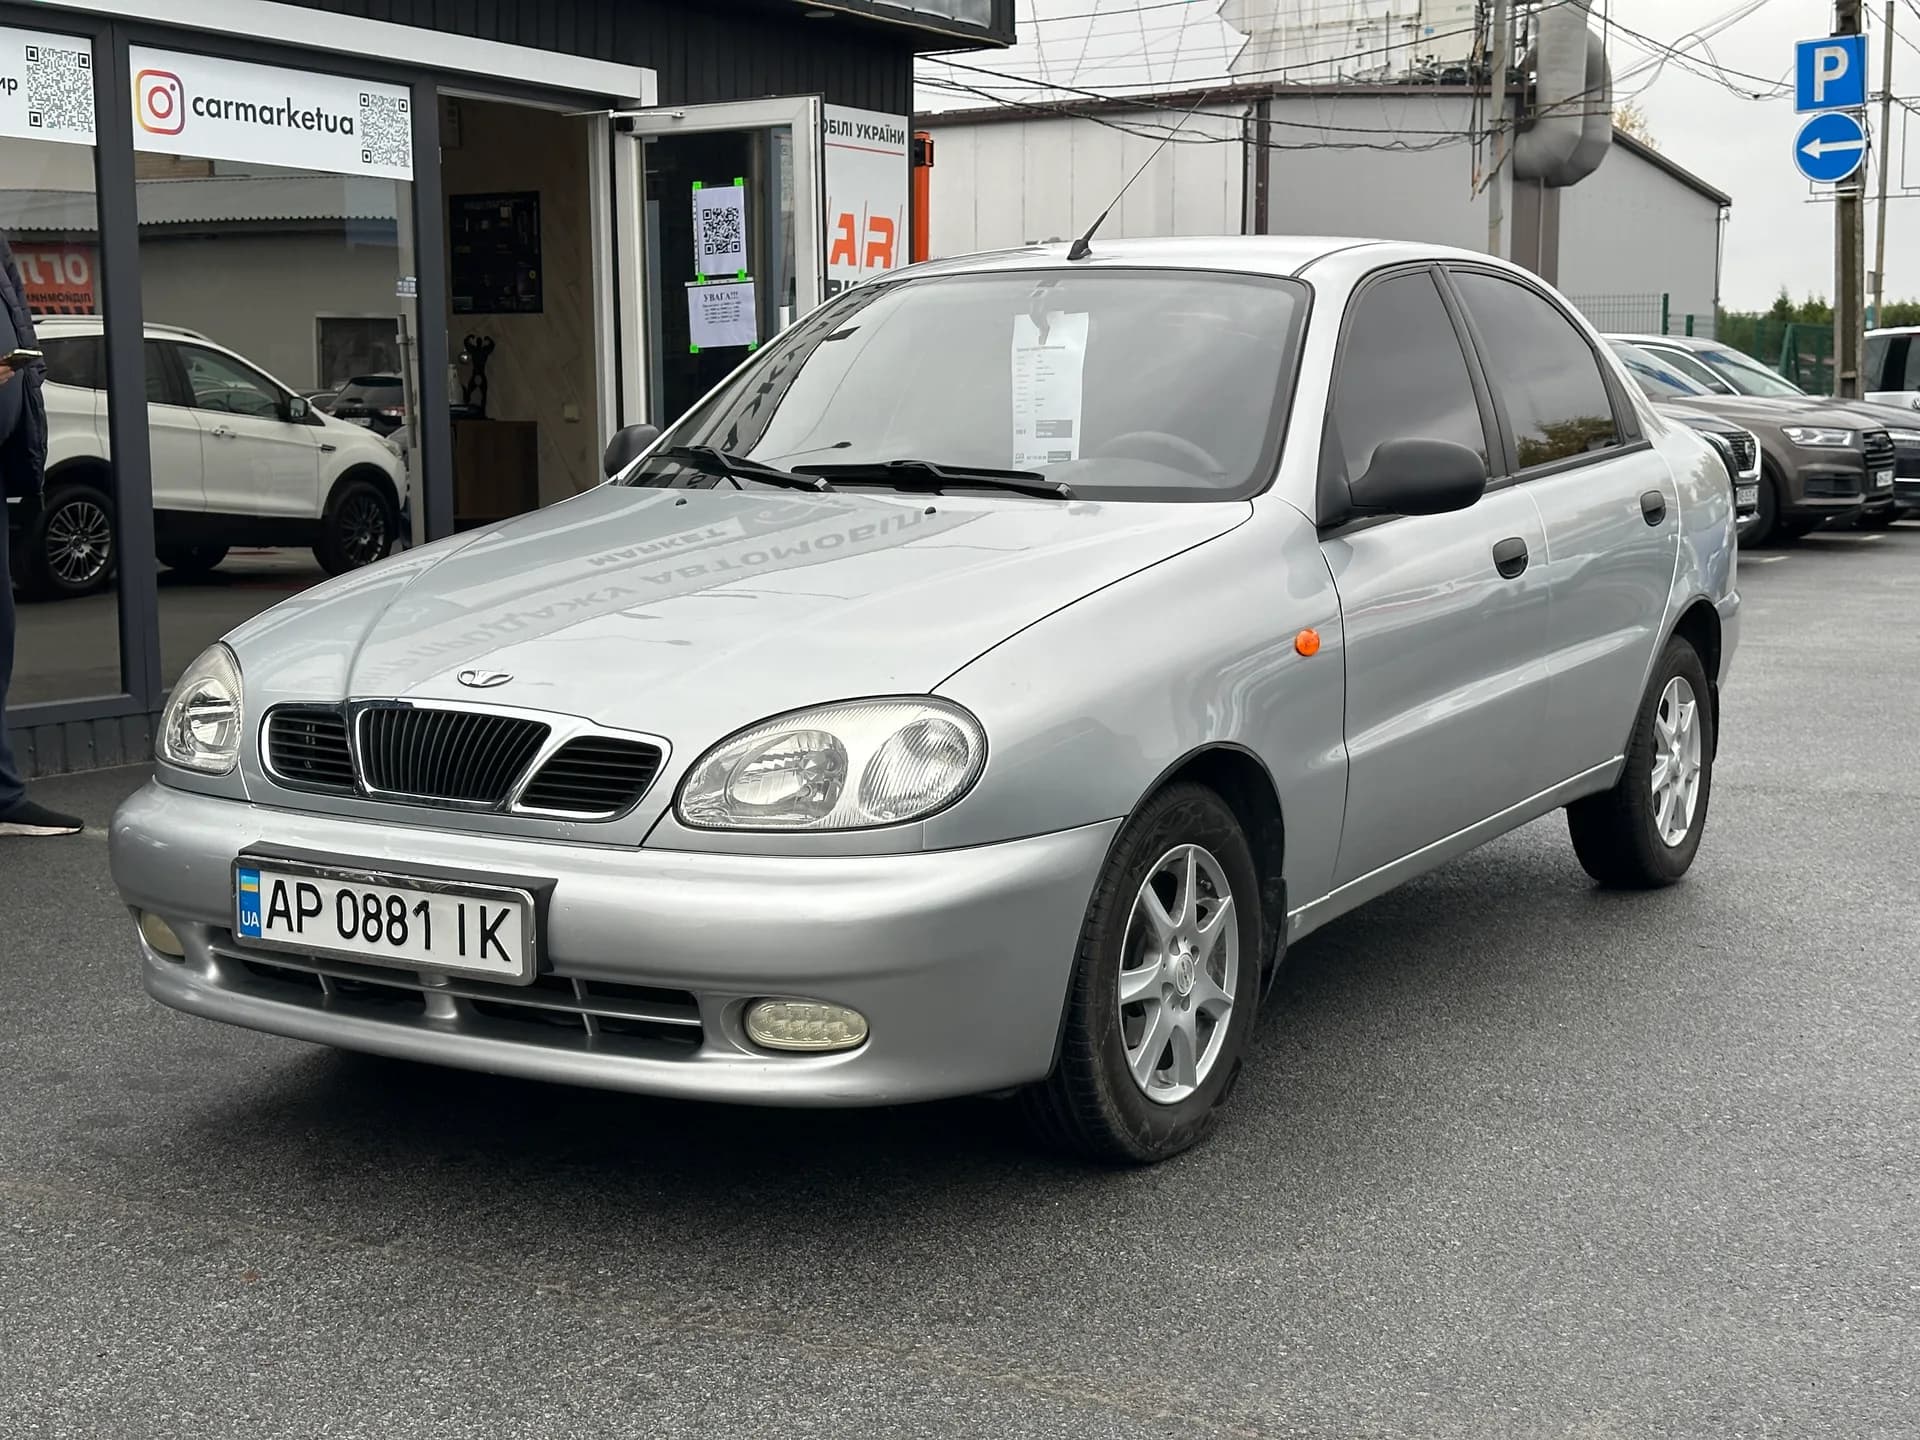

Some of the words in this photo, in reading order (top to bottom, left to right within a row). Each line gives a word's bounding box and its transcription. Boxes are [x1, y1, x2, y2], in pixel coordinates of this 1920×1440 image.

[1814, 47, 1848, 102] P
[192, 96, 354, 136] carmarketua
[856, 122, 905, 145] УКРАЇНИ
[703, 291, 738, 302] УВАГА!!!
[242, 910, 260, 928] UA
[266, 879, 323, 934] AP
[336, 888, 431, 951] 0881
[458, 903, 511, 962] IK
